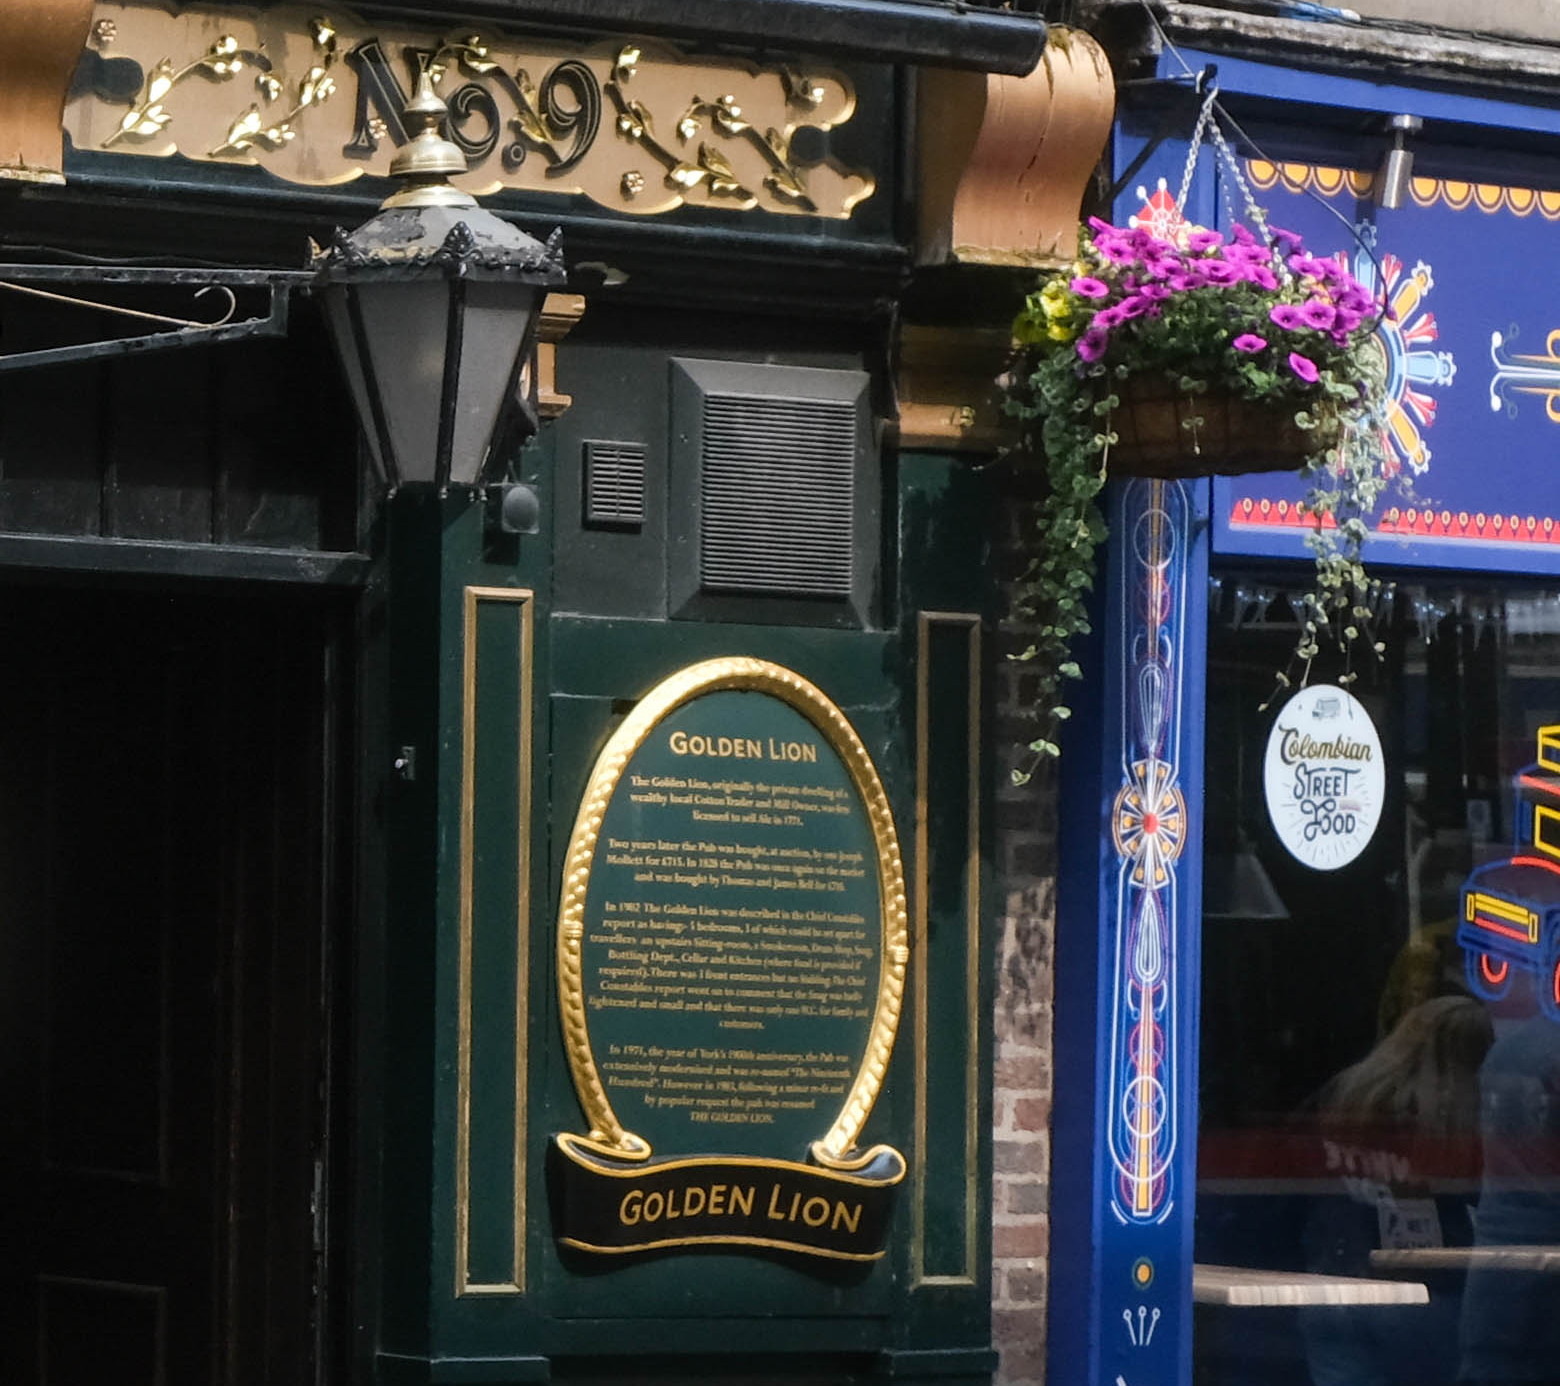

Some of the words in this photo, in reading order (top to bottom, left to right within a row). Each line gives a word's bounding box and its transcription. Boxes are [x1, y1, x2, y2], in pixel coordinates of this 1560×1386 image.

[670, 730, 763, 760] GOLDEN
[768, 737, 818, 763] LION
[1278, 724, 1373, 766] Colombian
[1293, 762, 1362, 800] STREET
[1299, 798, 1357, 842] FOOD
[620, 1184, 757, 1227] GOLDEN
[767, 1182, 863, 1234] LION
